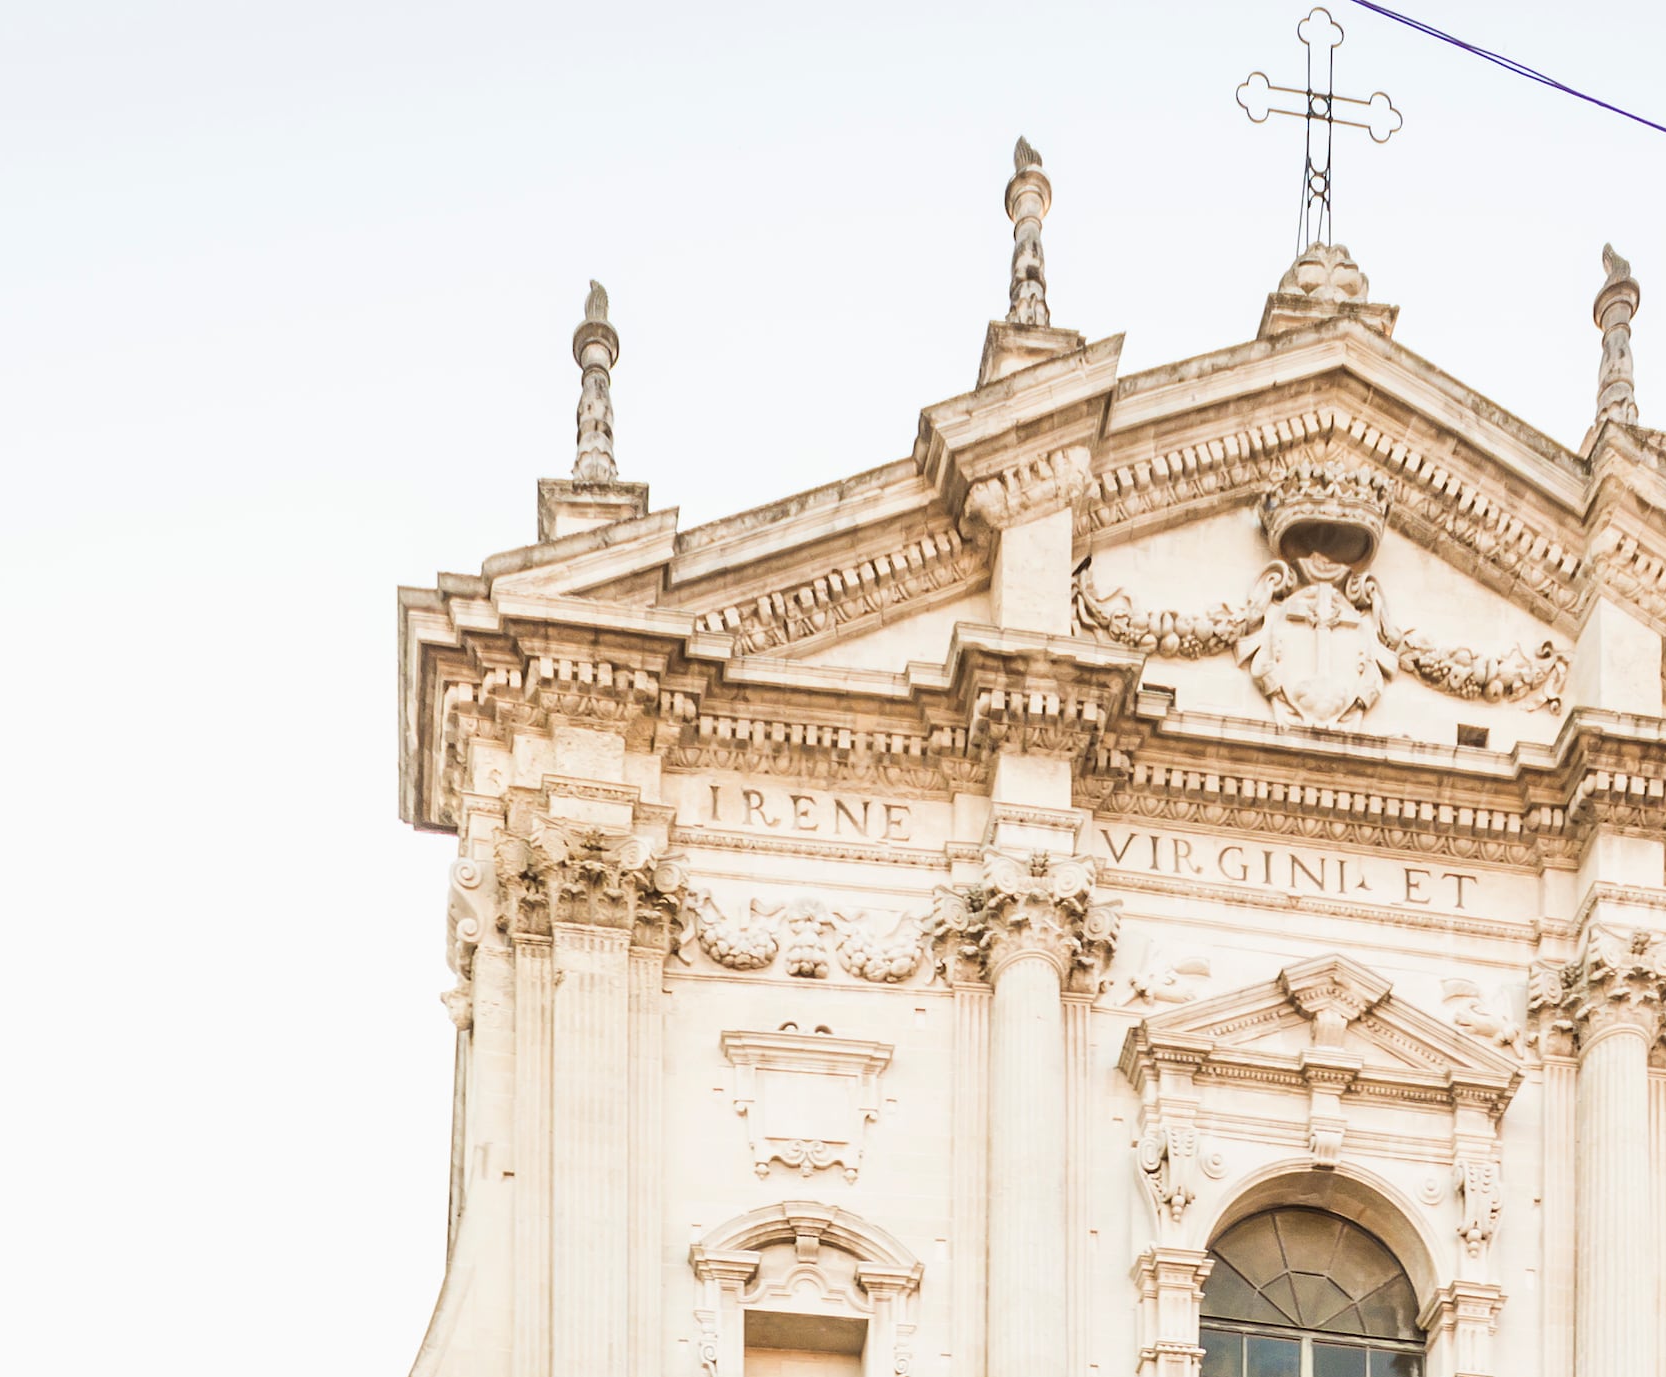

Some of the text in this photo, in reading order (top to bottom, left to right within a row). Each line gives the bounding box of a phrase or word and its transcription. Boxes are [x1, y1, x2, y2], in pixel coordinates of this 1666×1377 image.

[708, 784, 912, 842] IRENE
[1099, 828, 1478, 909] VIRGINI ET
